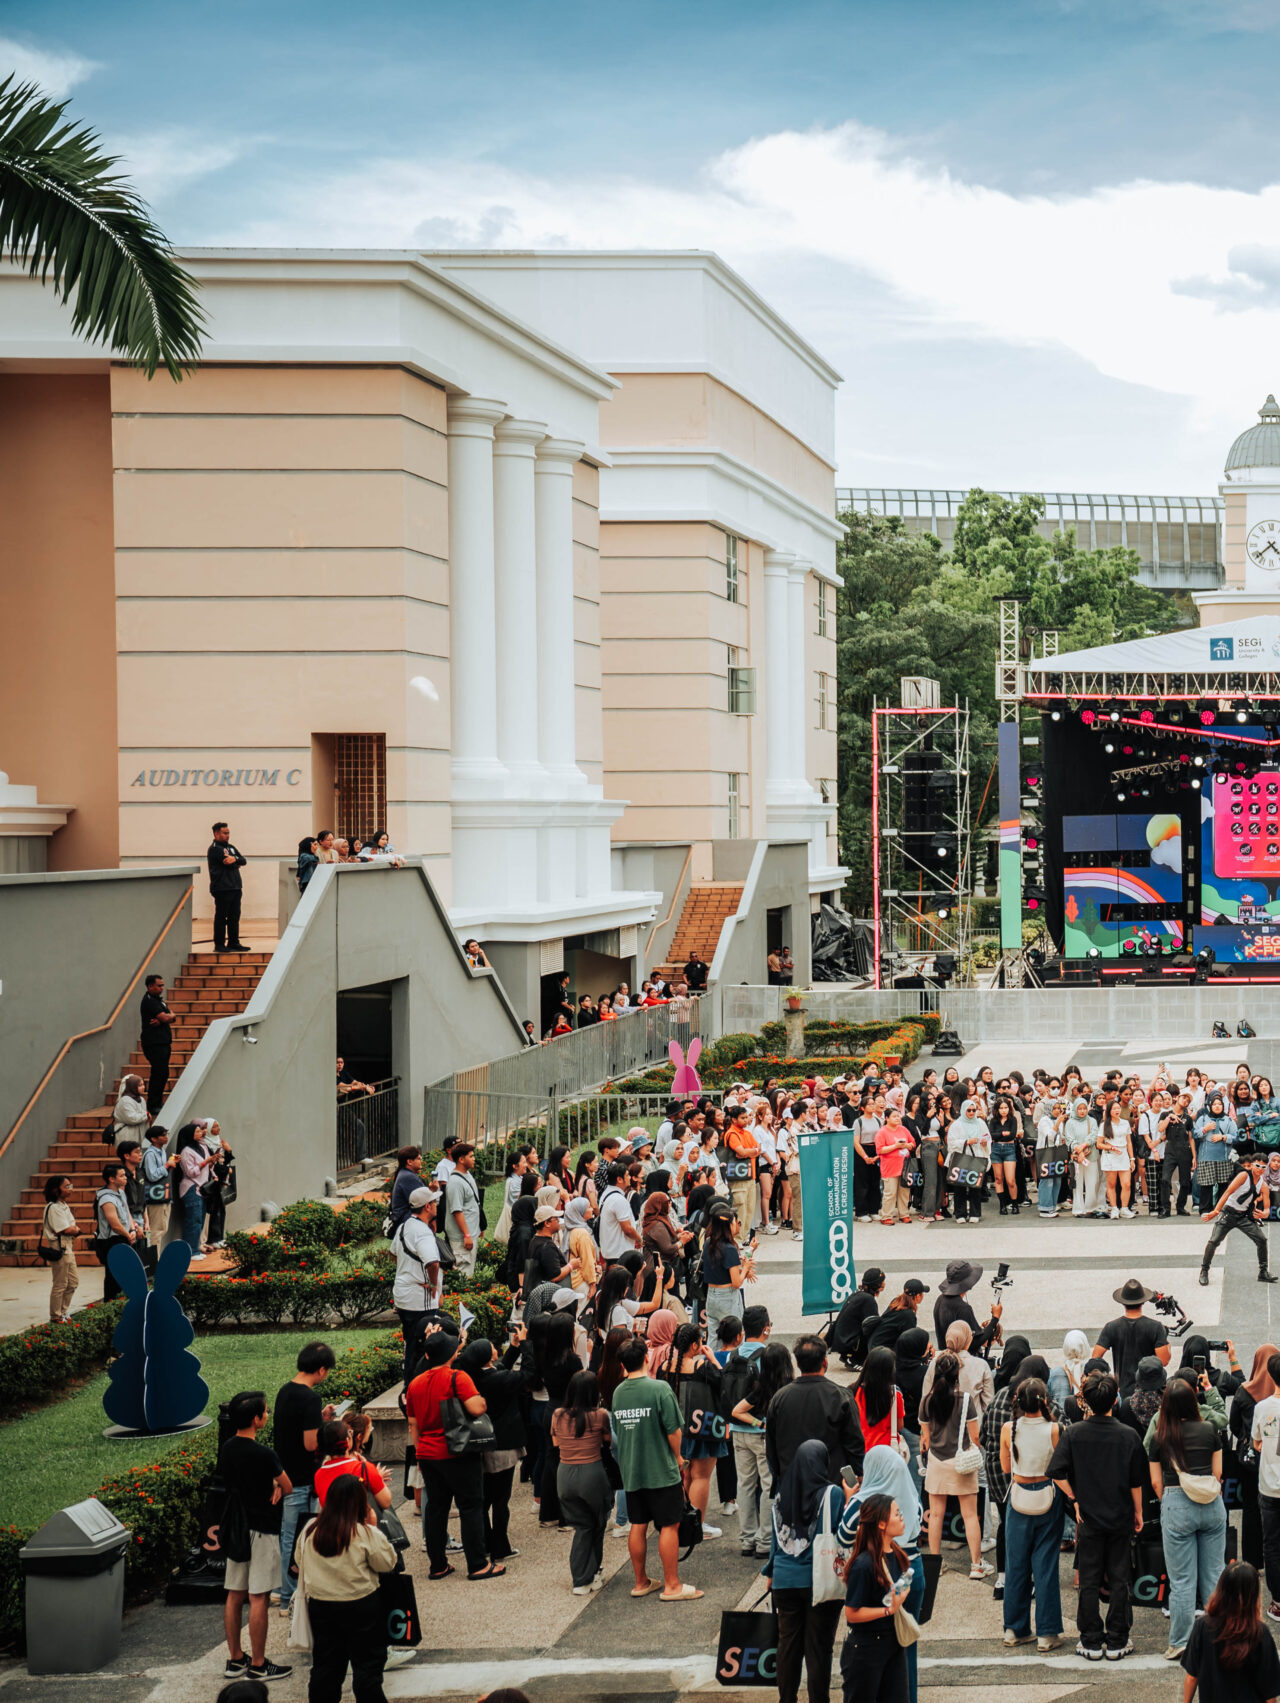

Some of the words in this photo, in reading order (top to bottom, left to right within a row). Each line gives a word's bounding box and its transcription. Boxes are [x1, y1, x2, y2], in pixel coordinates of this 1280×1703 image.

[131, 769, 280, 787] AUDITORIUM
[286, 768, 302, 786] C
[949, 1166, 983, 1187] SEGi
[1040, 1159, 1068, 1177] SEGi
[827, 1177, 833, 1187] OF
[719, 1646, 779, 1679] SEG
